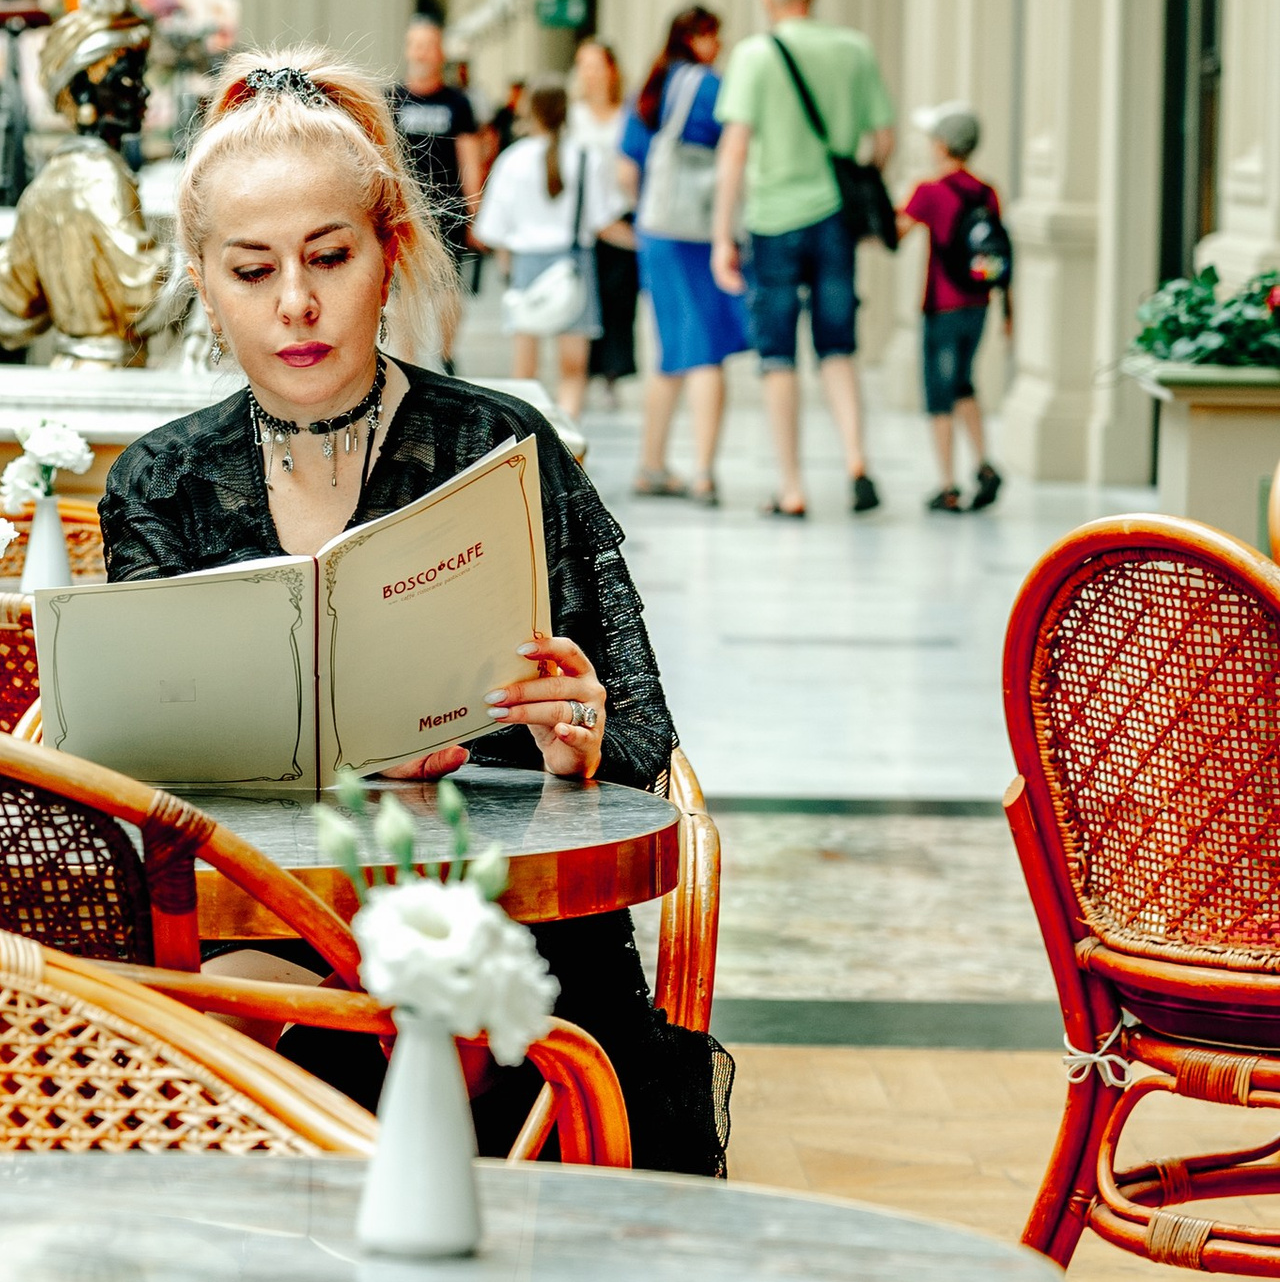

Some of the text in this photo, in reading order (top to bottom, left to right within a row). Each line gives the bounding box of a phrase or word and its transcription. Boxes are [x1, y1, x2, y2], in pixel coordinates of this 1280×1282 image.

[382, 542, 484, 599] BOSCO CAFE
[418, 707, 468, 732] Меню
